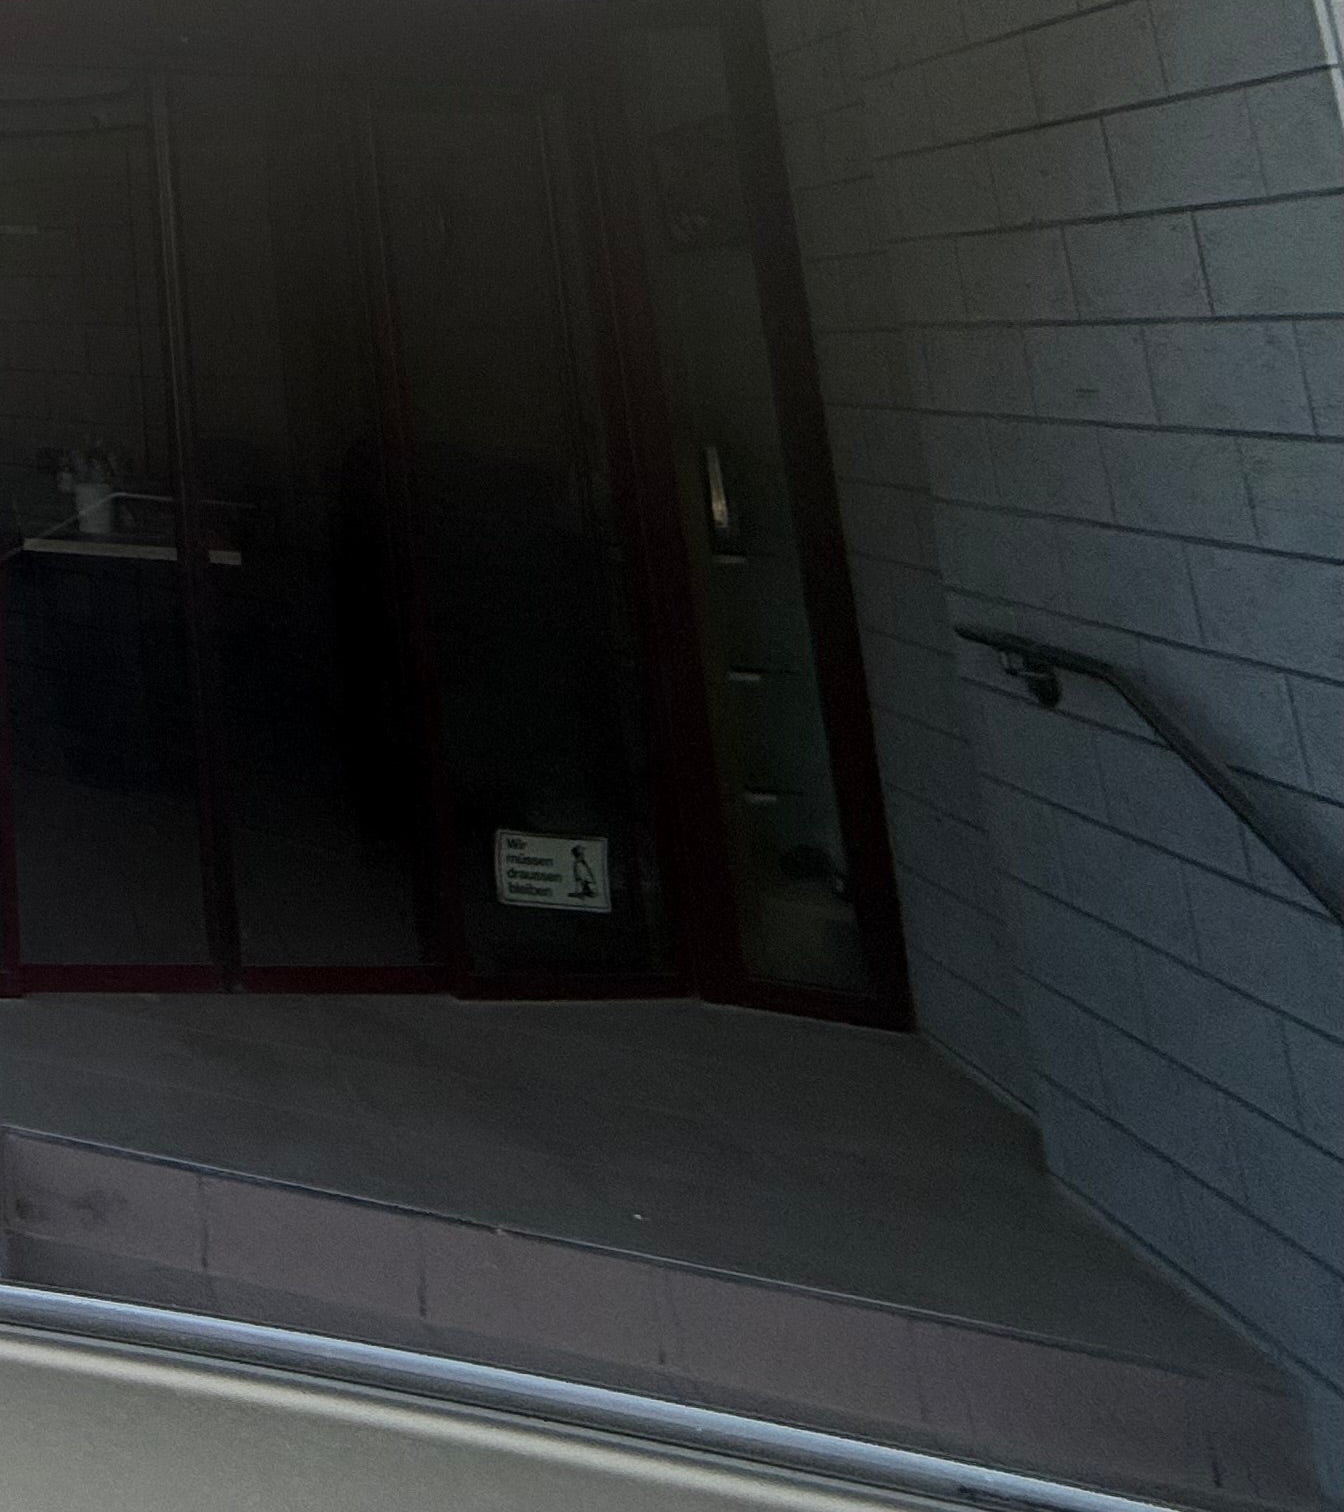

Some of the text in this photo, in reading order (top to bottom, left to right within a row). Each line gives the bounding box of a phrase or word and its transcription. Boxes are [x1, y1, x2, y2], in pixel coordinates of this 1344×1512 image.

[507, 838, 527, 849] Wir
[506, 855, 554, 867] müssen
[507, 868, 562, 882] draussen
[507, 882, 553, 896] bleiben
